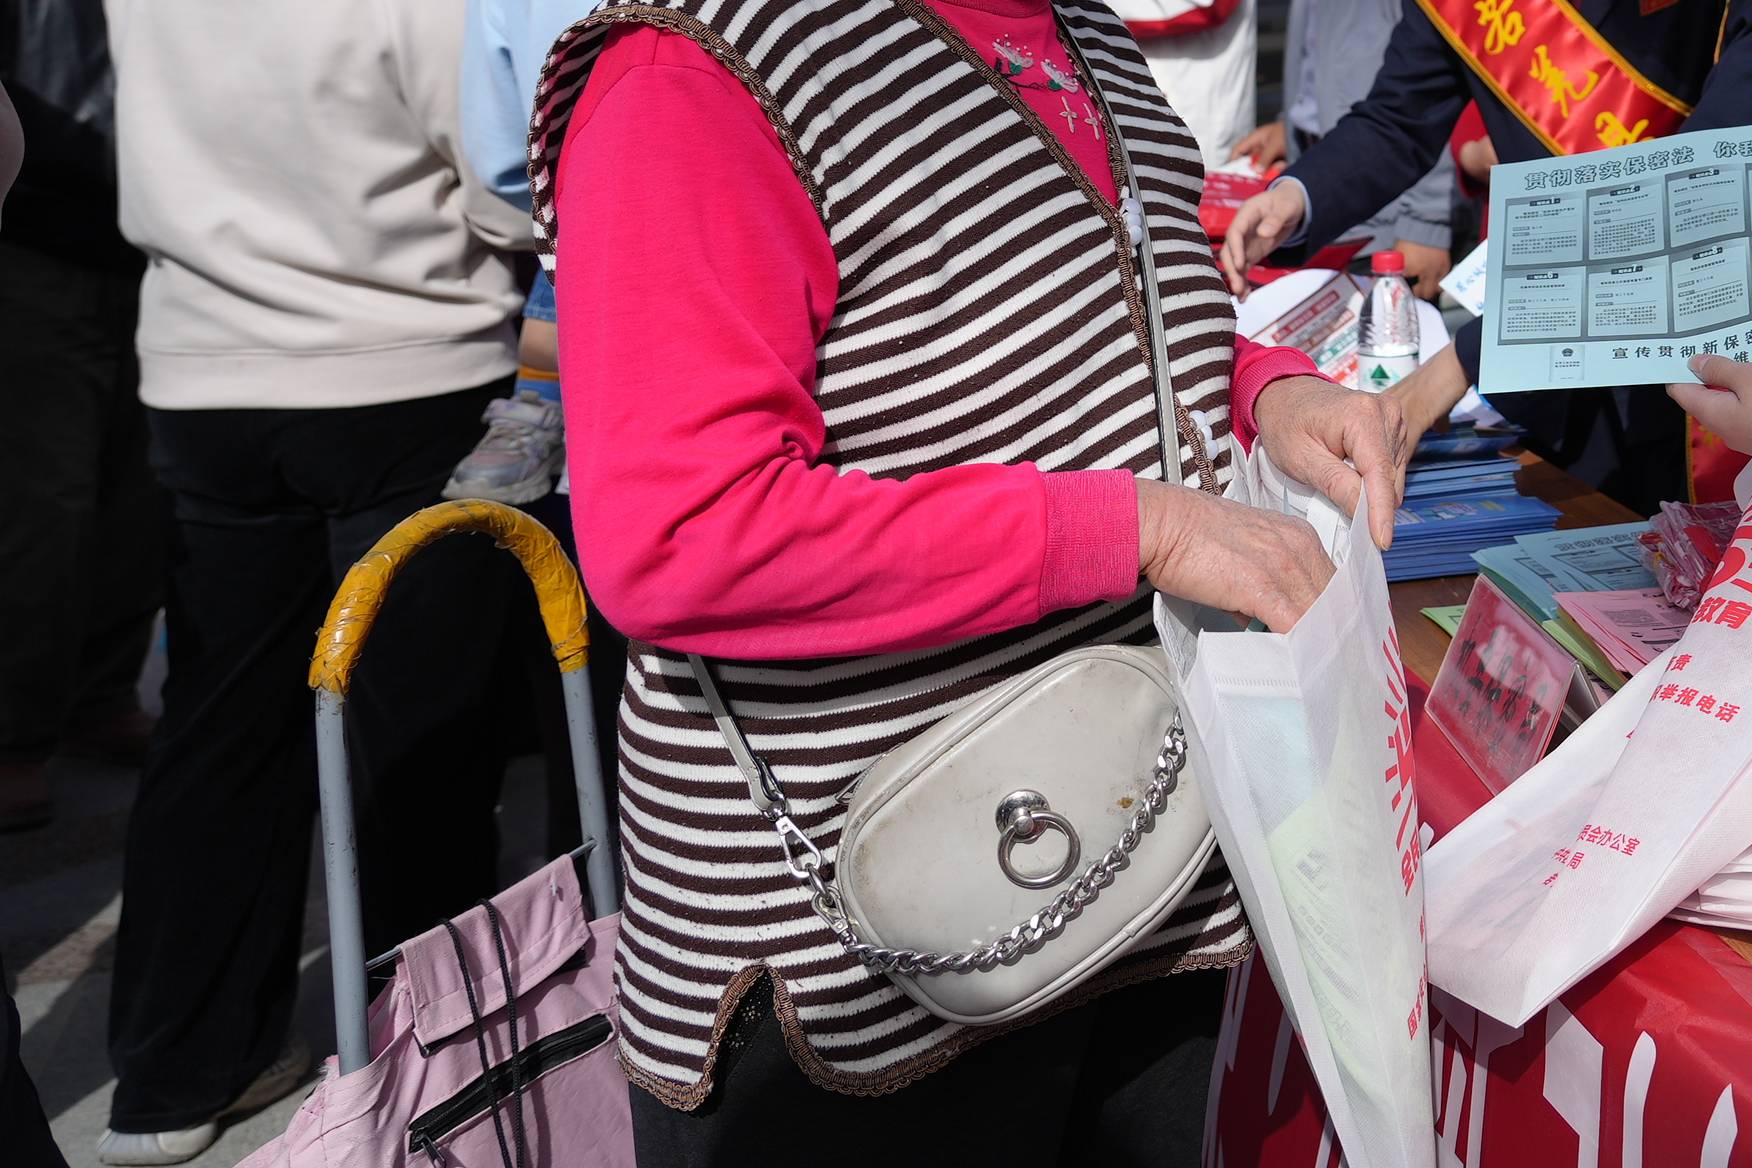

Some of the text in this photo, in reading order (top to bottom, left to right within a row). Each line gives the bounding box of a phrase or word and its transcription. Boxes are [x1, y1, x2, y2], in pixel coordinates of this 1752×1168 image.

[1525, 146, 1695, 190] 贯彻落实保密法
